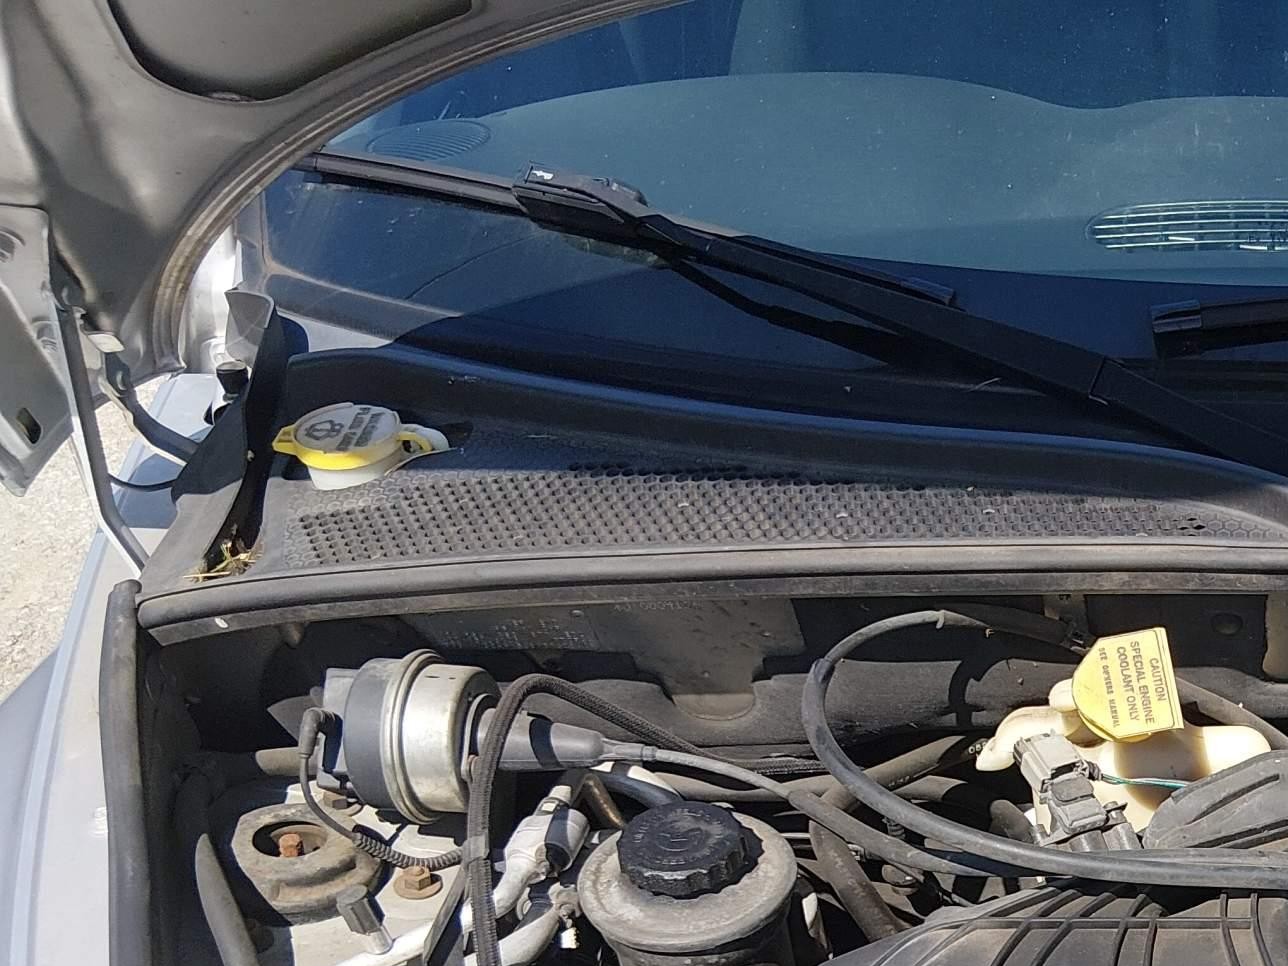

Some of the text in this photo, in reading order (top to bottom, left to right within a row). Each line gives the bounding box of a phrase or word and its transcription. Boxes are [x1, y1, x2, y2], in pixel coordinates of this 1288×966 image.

[1116, 646, 1140, 722] COOLANT ONLY
[1130, 640, 1155, 724] SPECIAL ENGINE
[1150, 658, 1167, 702] CAUTION
